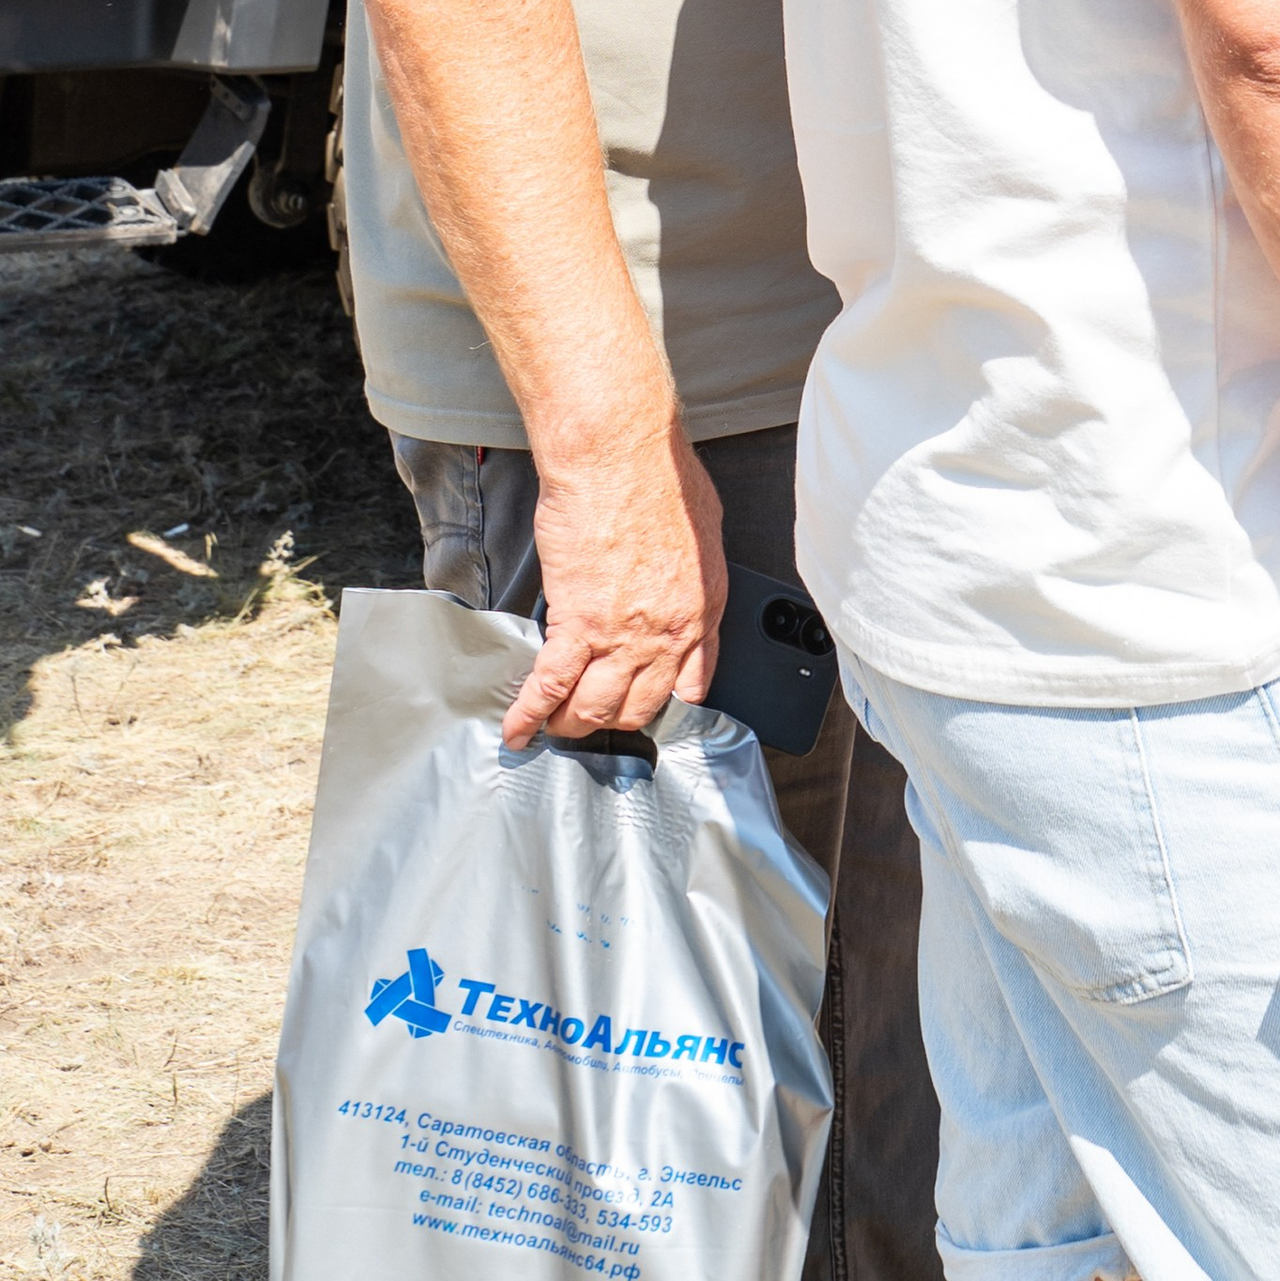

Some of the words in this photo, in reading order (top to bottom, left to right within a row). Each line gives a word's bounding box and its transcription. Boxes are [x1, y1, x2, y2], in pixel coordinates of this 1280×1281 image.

[338, 1100, 409, 1127] 413124,
[417, 1112, 551, 1153] Саратовская
[660, 1165, 743, 1191] Энгельс
[401, 1134, 429, 1153] 1-й
[435, 1140, 573, 1186] Студенческий
[650, 1190, 675, 1209] 2А
[394, 1160, 448, 1182] тел.:
[527, 1182, 590, 1224] 686-333,
[596, 1209, 673, 1234] 534-593
[420, 1190, 483, 1214] e-mail:
[488, 1202, 640, 1256] technoal@mail.ru
